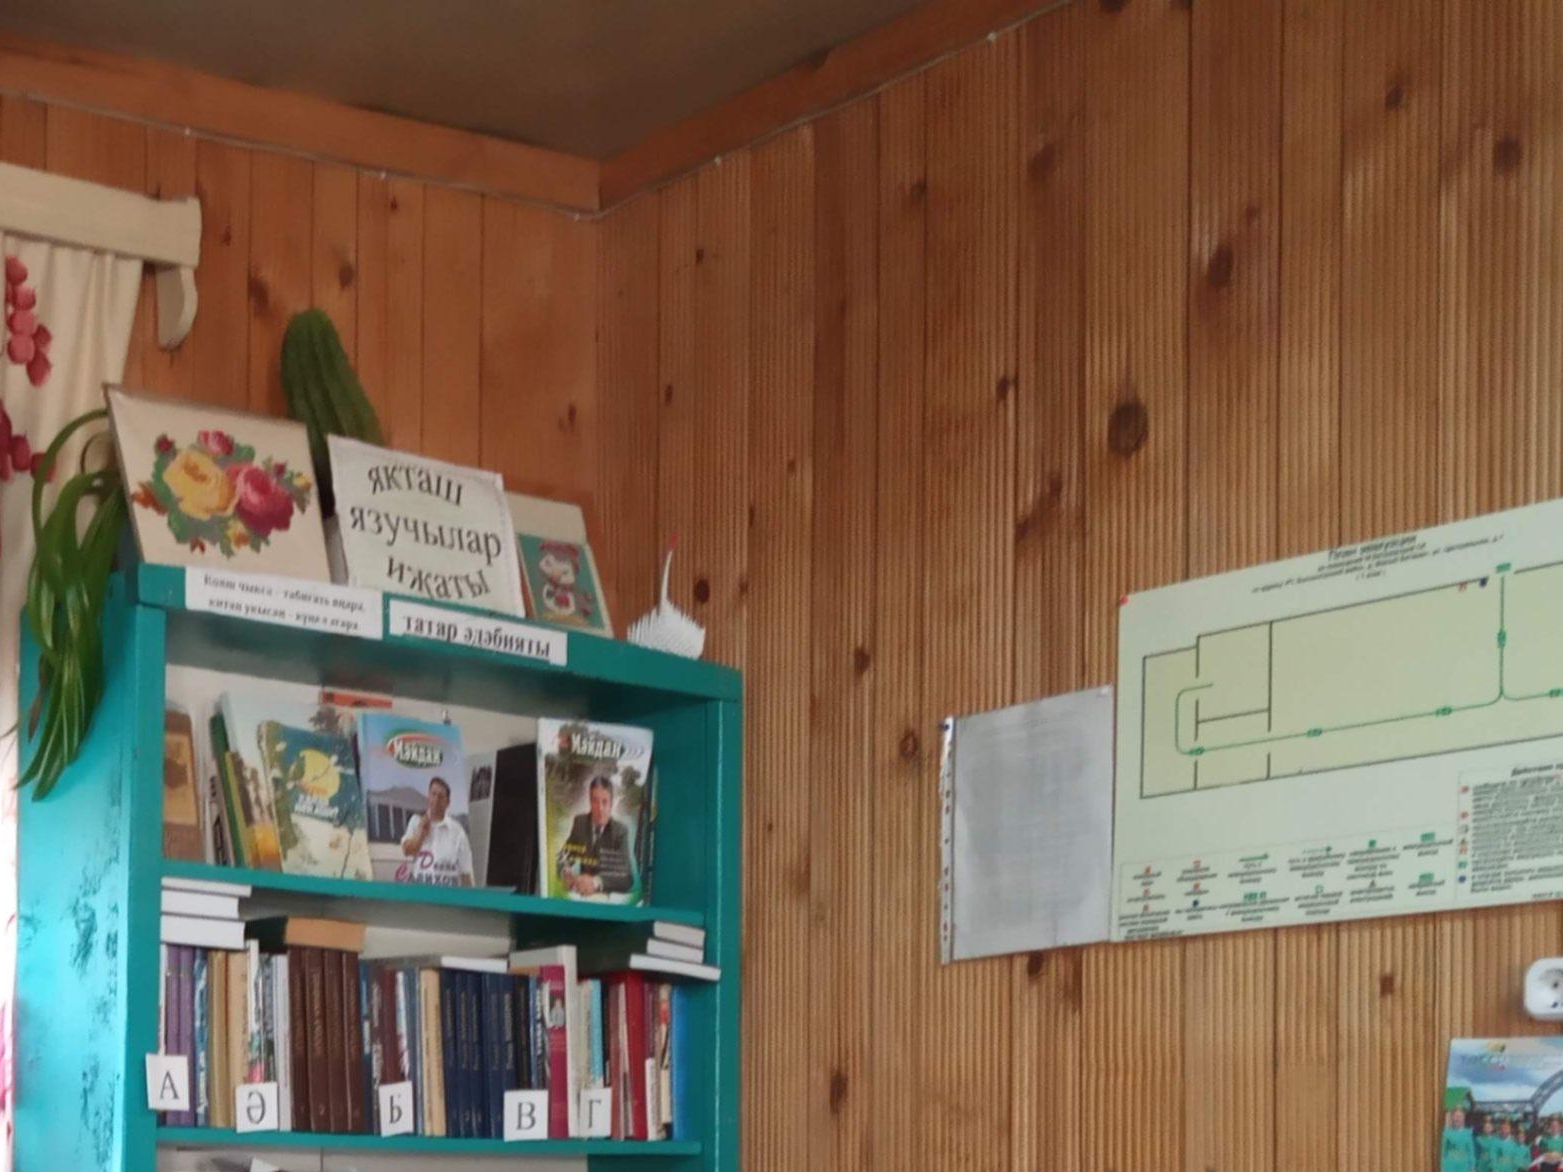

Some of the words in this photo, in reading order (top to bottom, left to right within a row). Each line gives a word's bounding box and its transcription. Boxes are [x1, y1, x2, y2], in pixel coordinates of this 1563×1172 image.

[368, 465, 462, 506] якташ
[349, 506, 501, 566] язучылар
[387, 556, 490, 600] ижаты
[403, 616, 458, 642] татар
[160, 1071, 179, 1099] А
[247, 1092, 265, 1124] Ә
[517, 1102, 536, 1130] В
[588, 1099, 601, 1129] Г
